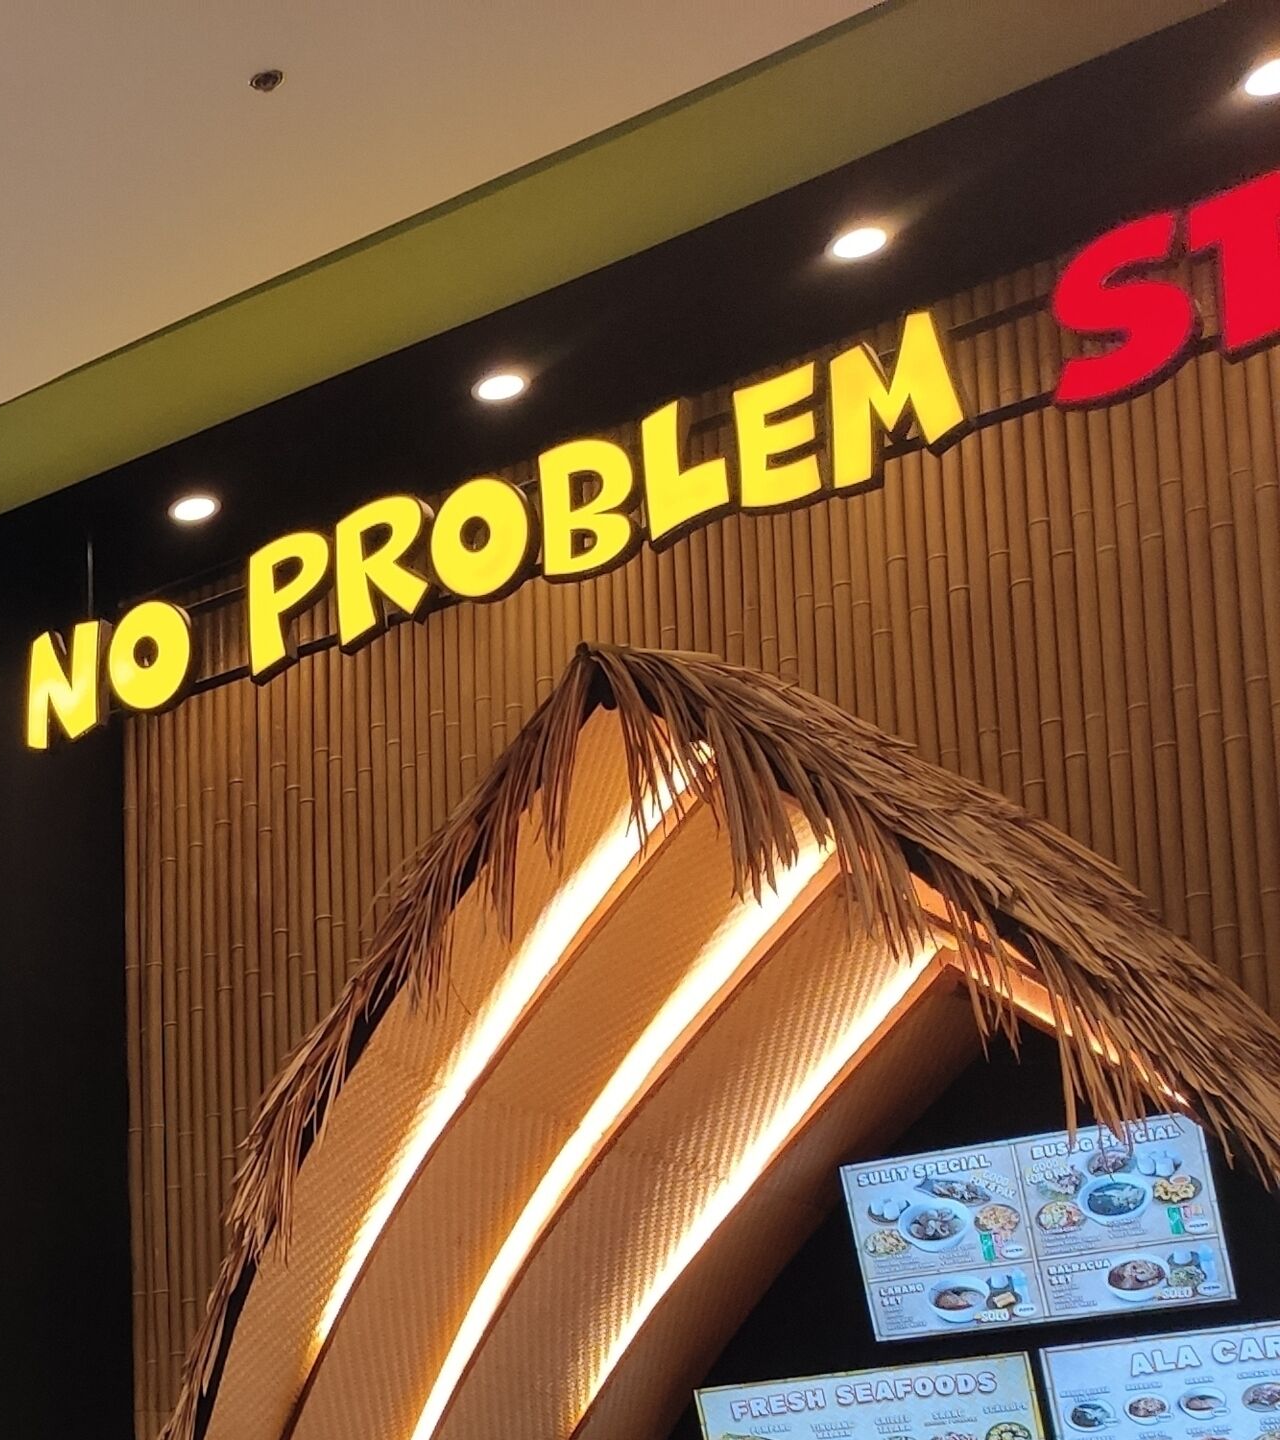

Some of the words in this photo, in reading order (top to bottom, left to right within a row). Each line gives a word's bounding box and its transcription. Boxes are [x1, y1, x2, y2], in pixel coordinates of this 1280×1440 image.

[26, 602, 193, 750] NO
[246, 312, 964, 680] PROBLEM
[857, 1167, 908, 1187] SULIT
[913, 1153, 991, 1178] SPECIAL
[1130, 1345, 1202, 1377] ALA
[730, 1387, 827, 1422] FRESH
[835, 1371, 998, 1406] SEAFOODS
